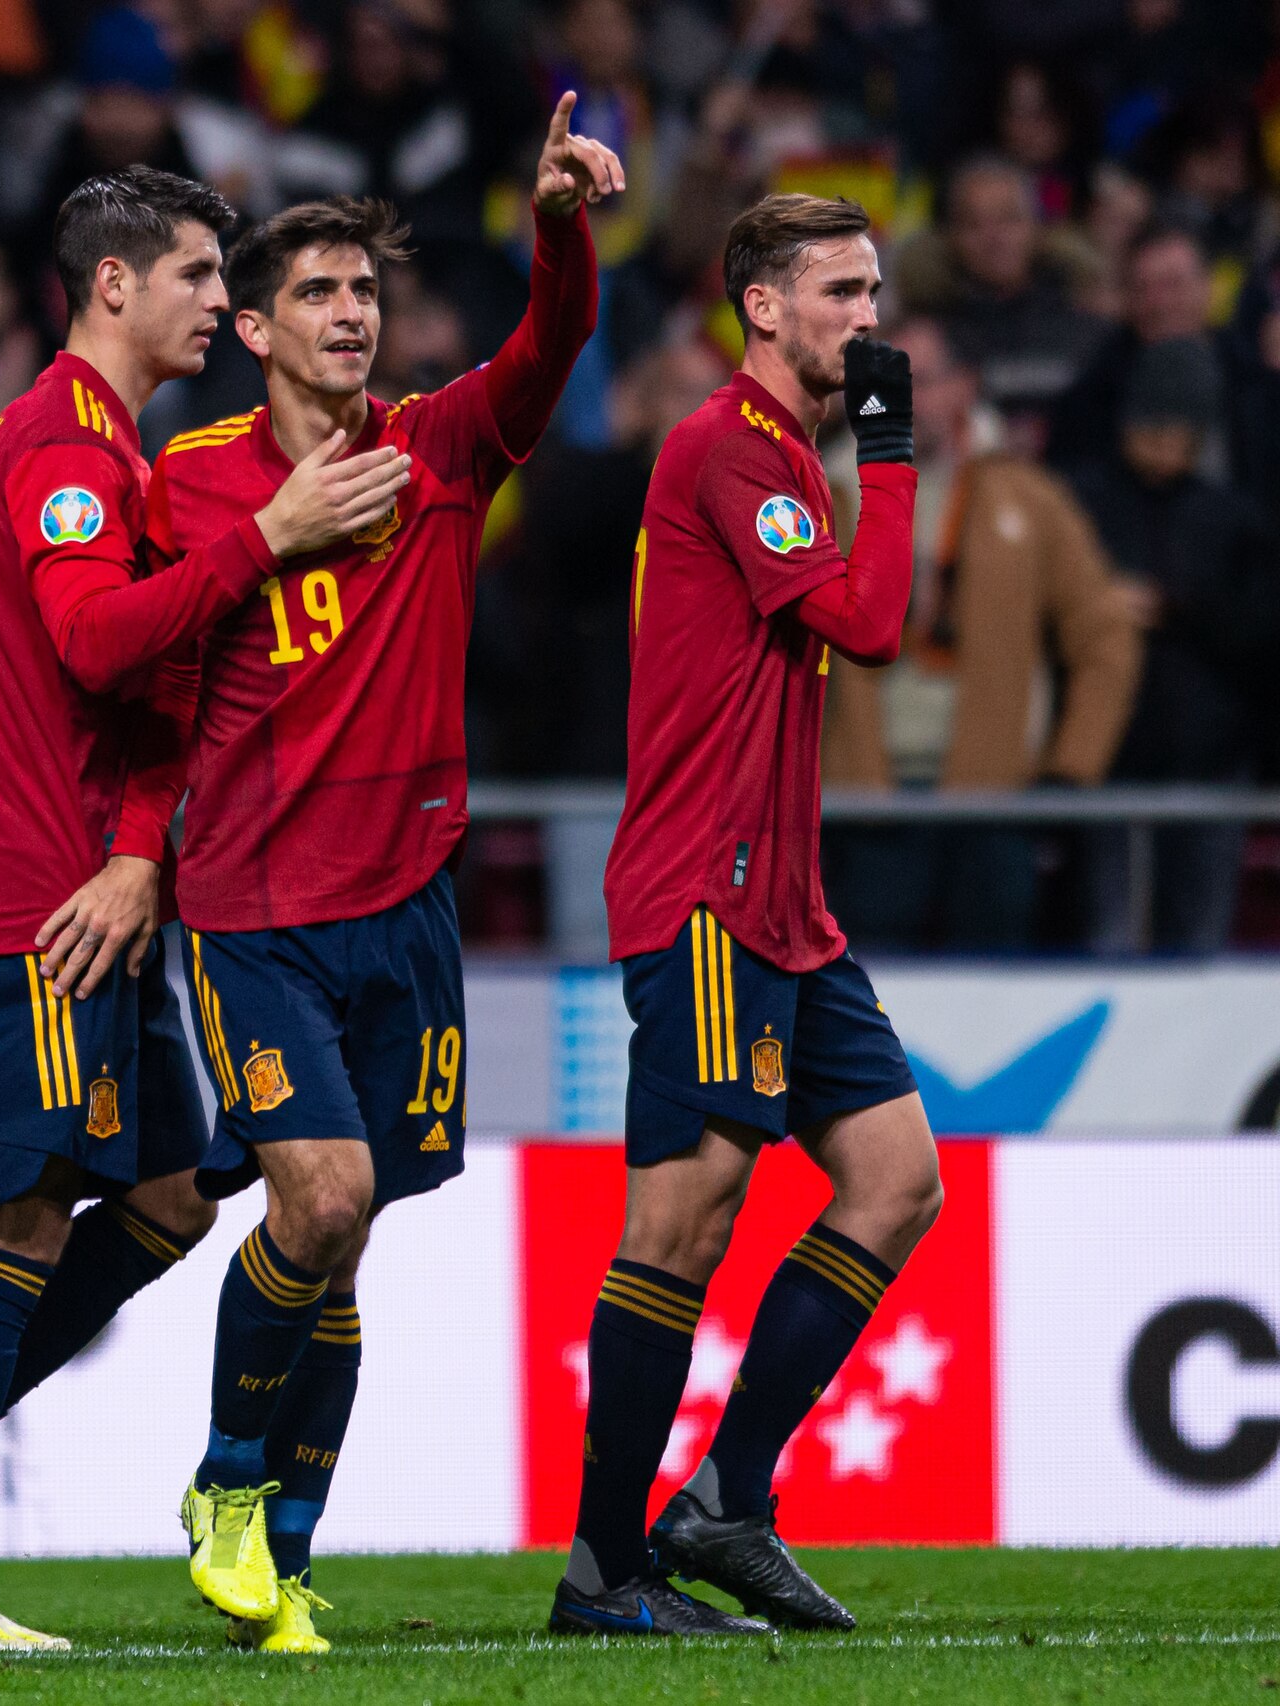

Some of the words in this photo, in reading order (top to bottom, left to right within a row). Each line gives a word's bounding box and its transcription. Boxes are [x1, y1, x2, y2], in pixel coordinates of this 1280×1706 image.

[859, 406, 887, 416] adidas
[261, 569, 345, 665] 19
[406, 1026, 461, 1114] 19
[420, 1140, 450, 1152] adidas
